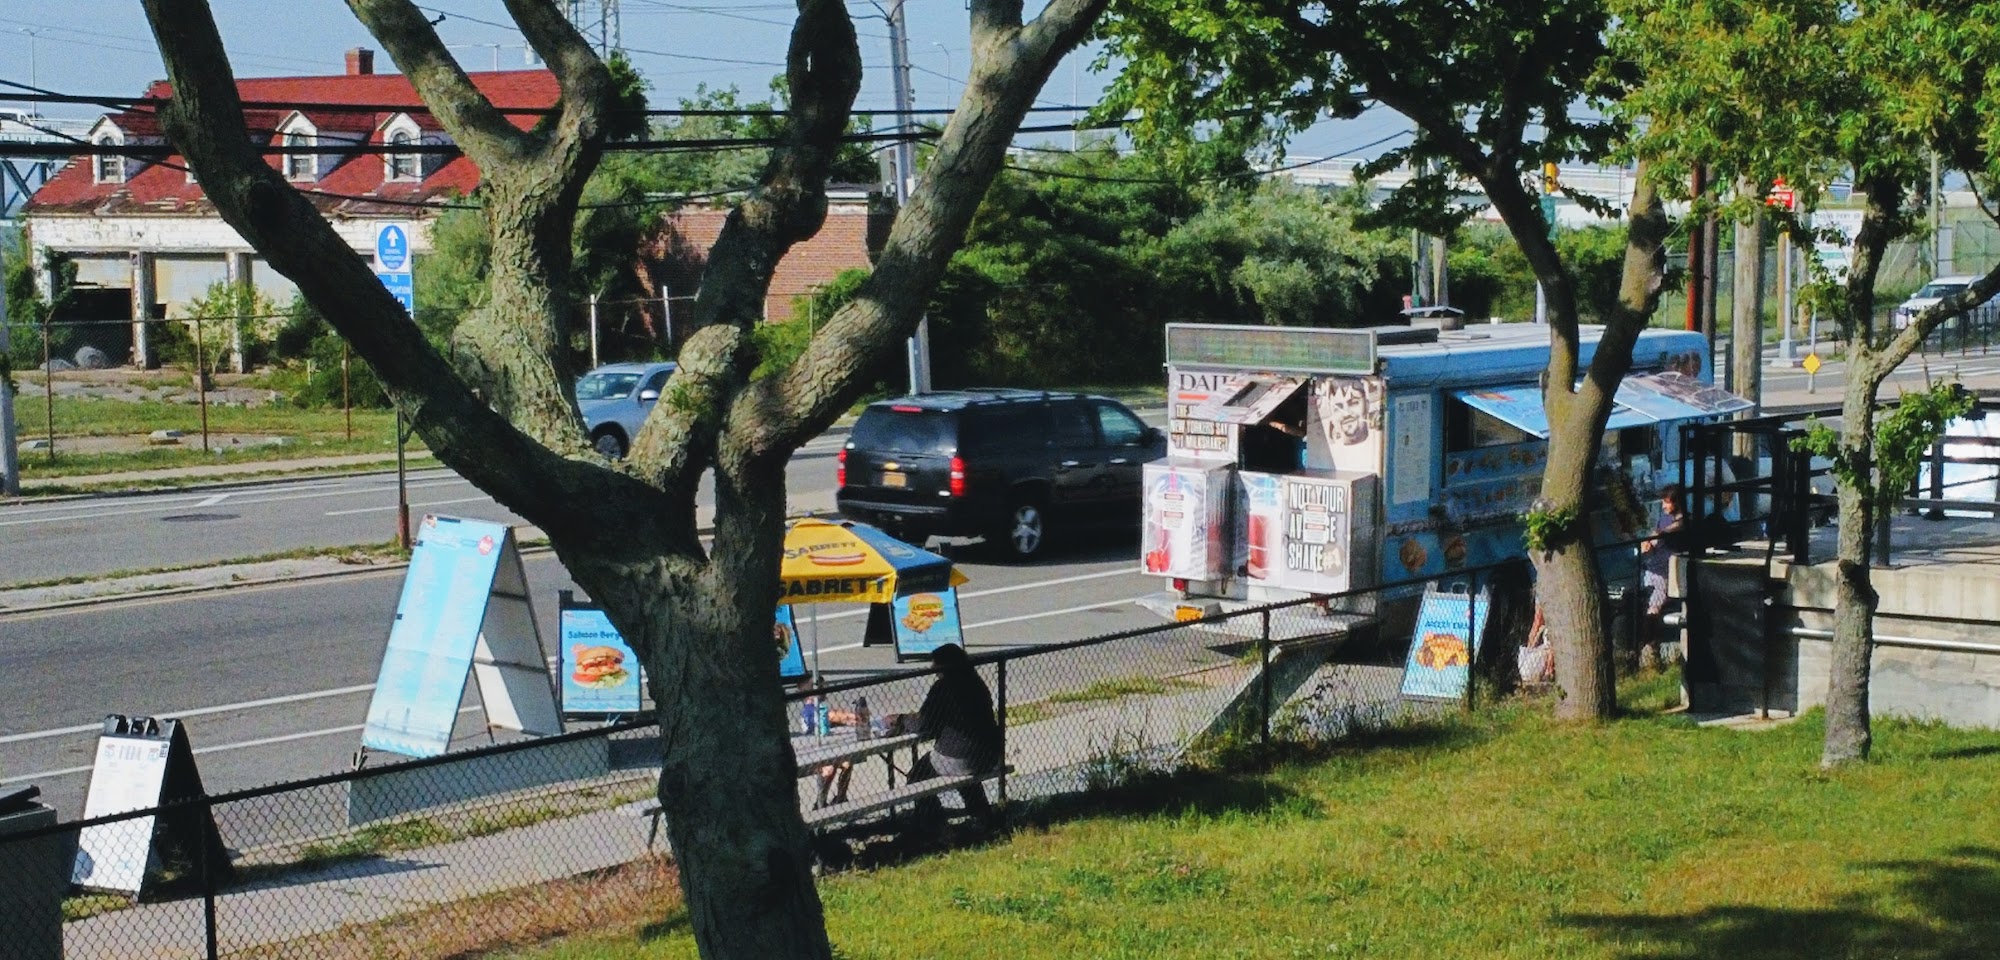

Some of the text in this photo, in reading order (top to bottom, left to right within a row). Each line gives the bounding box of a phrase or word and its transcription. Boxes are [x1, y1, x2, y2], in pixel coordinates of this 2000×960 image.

[1289, 482, 1345, 513] NOT YOUR
[784, 541, 857, 560] SABRETT
[1288, 542, 1324, 572] SHAKE
[568, 631, 598, 639] Salmon
